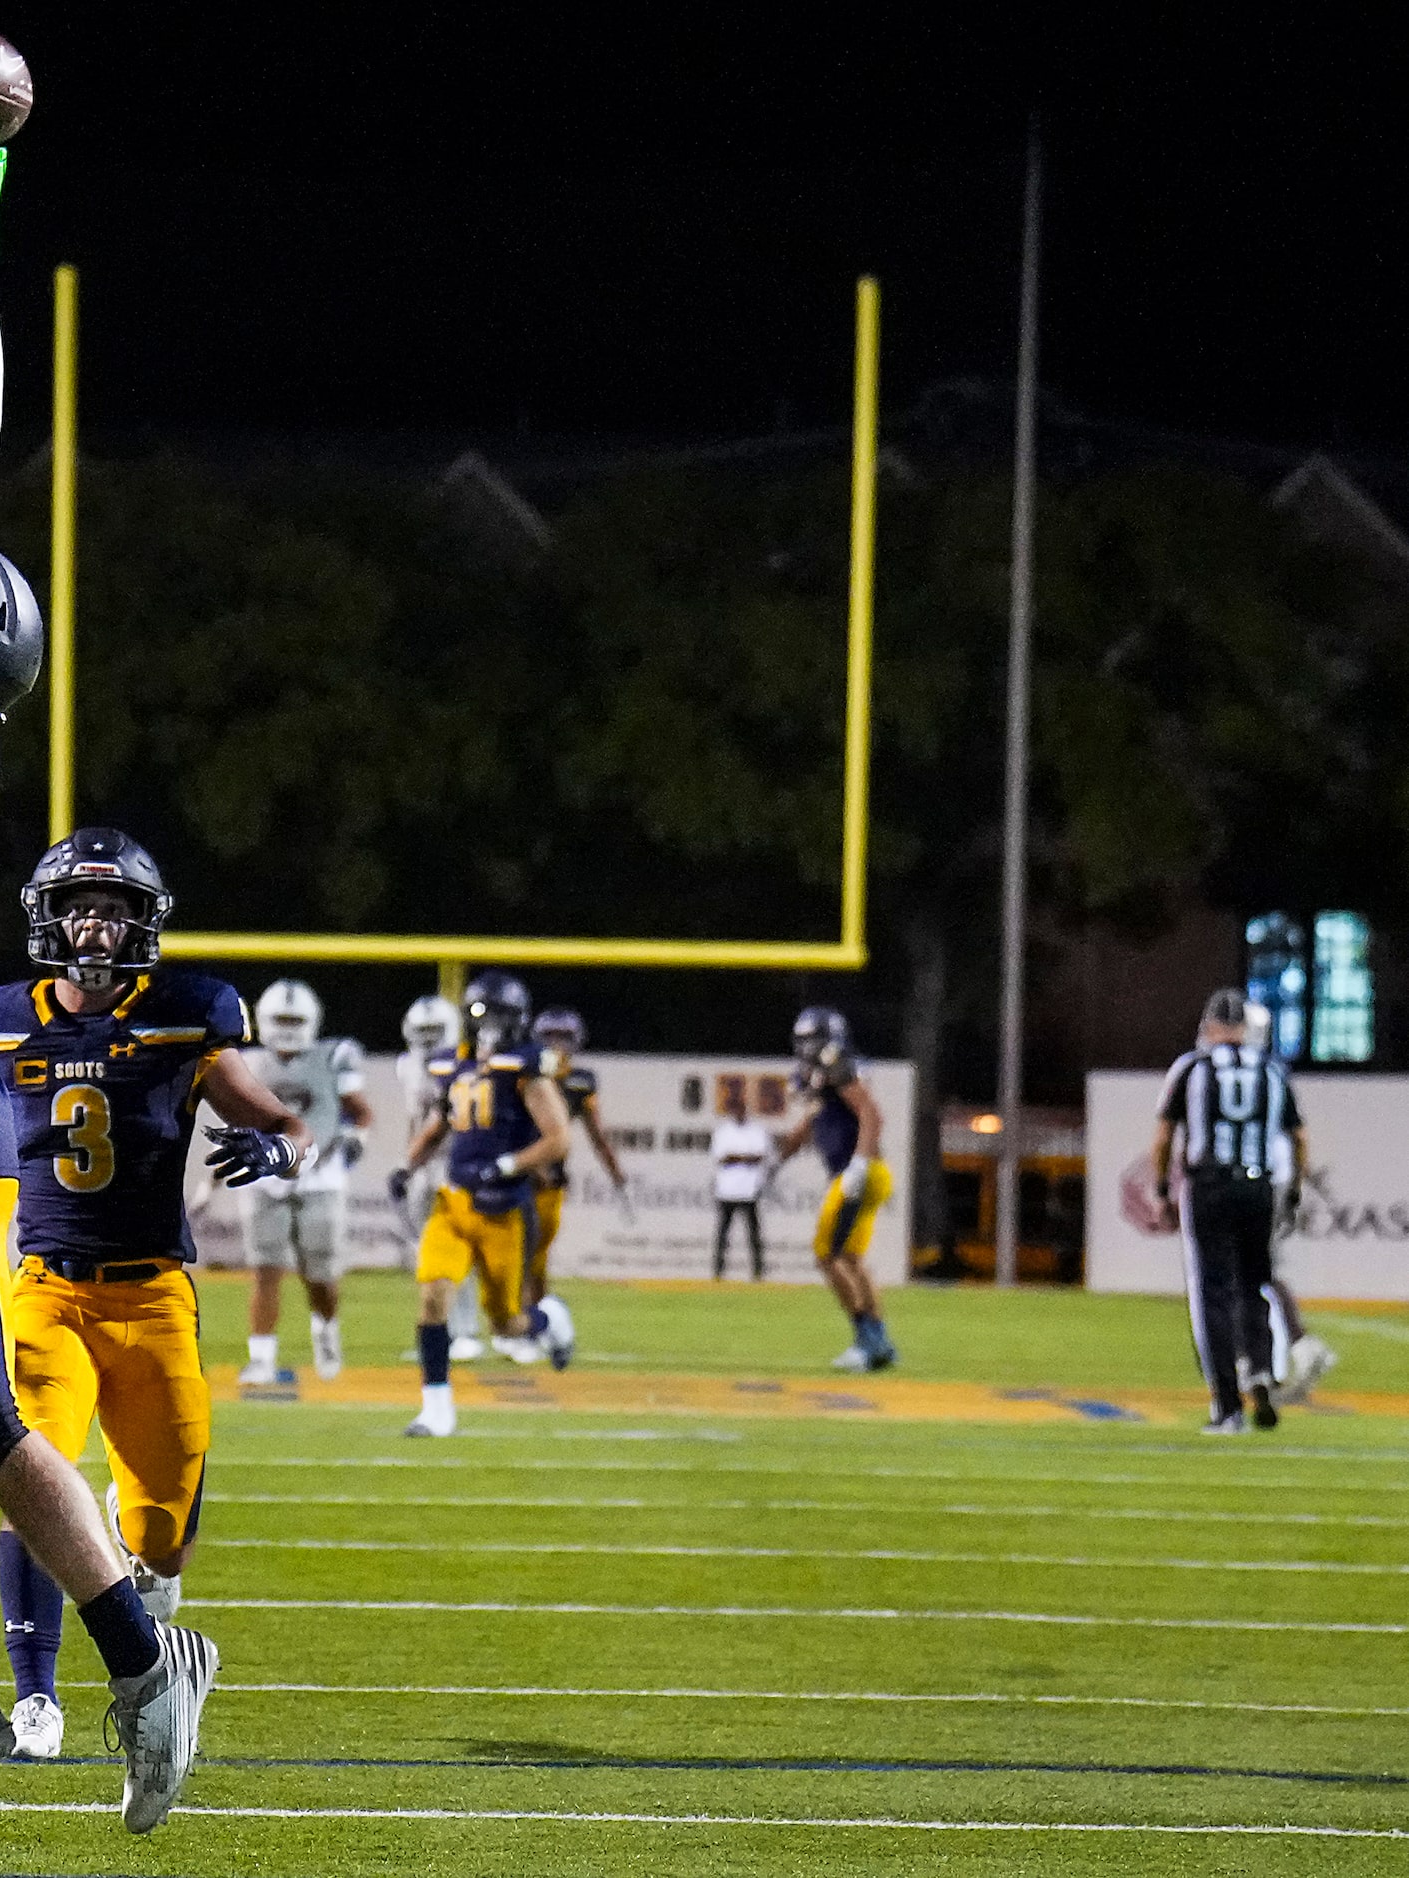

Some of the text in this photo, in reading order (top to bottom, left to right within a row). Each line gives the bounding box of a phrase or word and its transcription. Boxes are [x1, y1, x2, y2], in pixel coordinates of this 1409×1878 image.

[14, 1060, 48, 1085] C
[1215, 1067, 1258, 1120] U
[50, 1084, 115, 1194] 3
